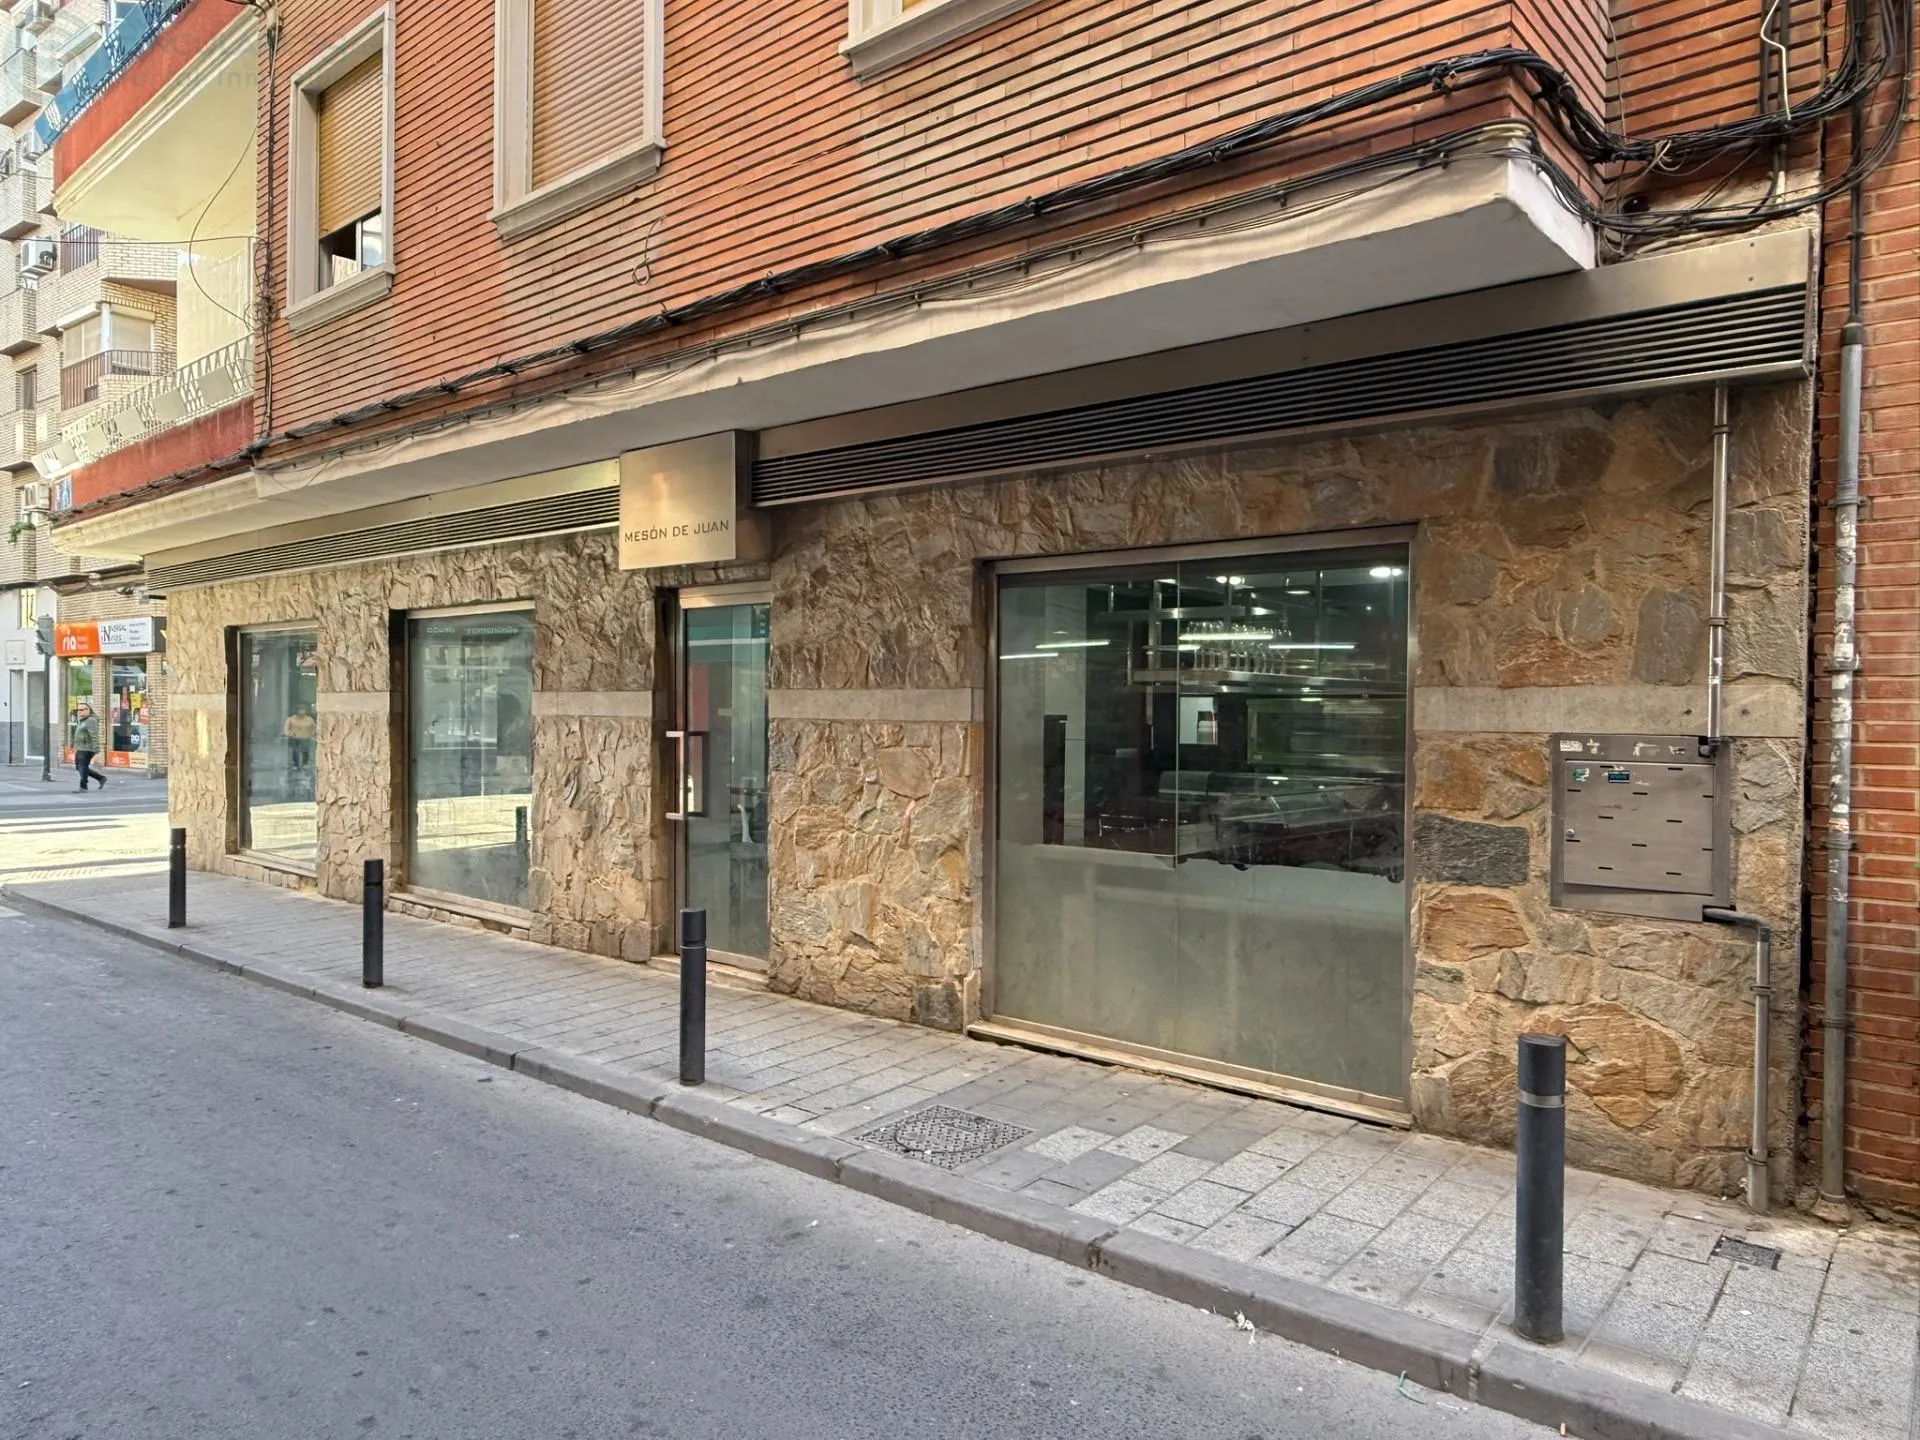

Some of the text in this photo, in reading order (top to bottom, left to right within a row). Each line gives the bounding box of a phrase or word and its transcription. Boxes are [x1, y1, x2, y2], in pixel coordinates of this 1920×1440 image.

[624, 520, 729, 543] MESÓN DE JUAN
[62, 629, 77, 651] ria
